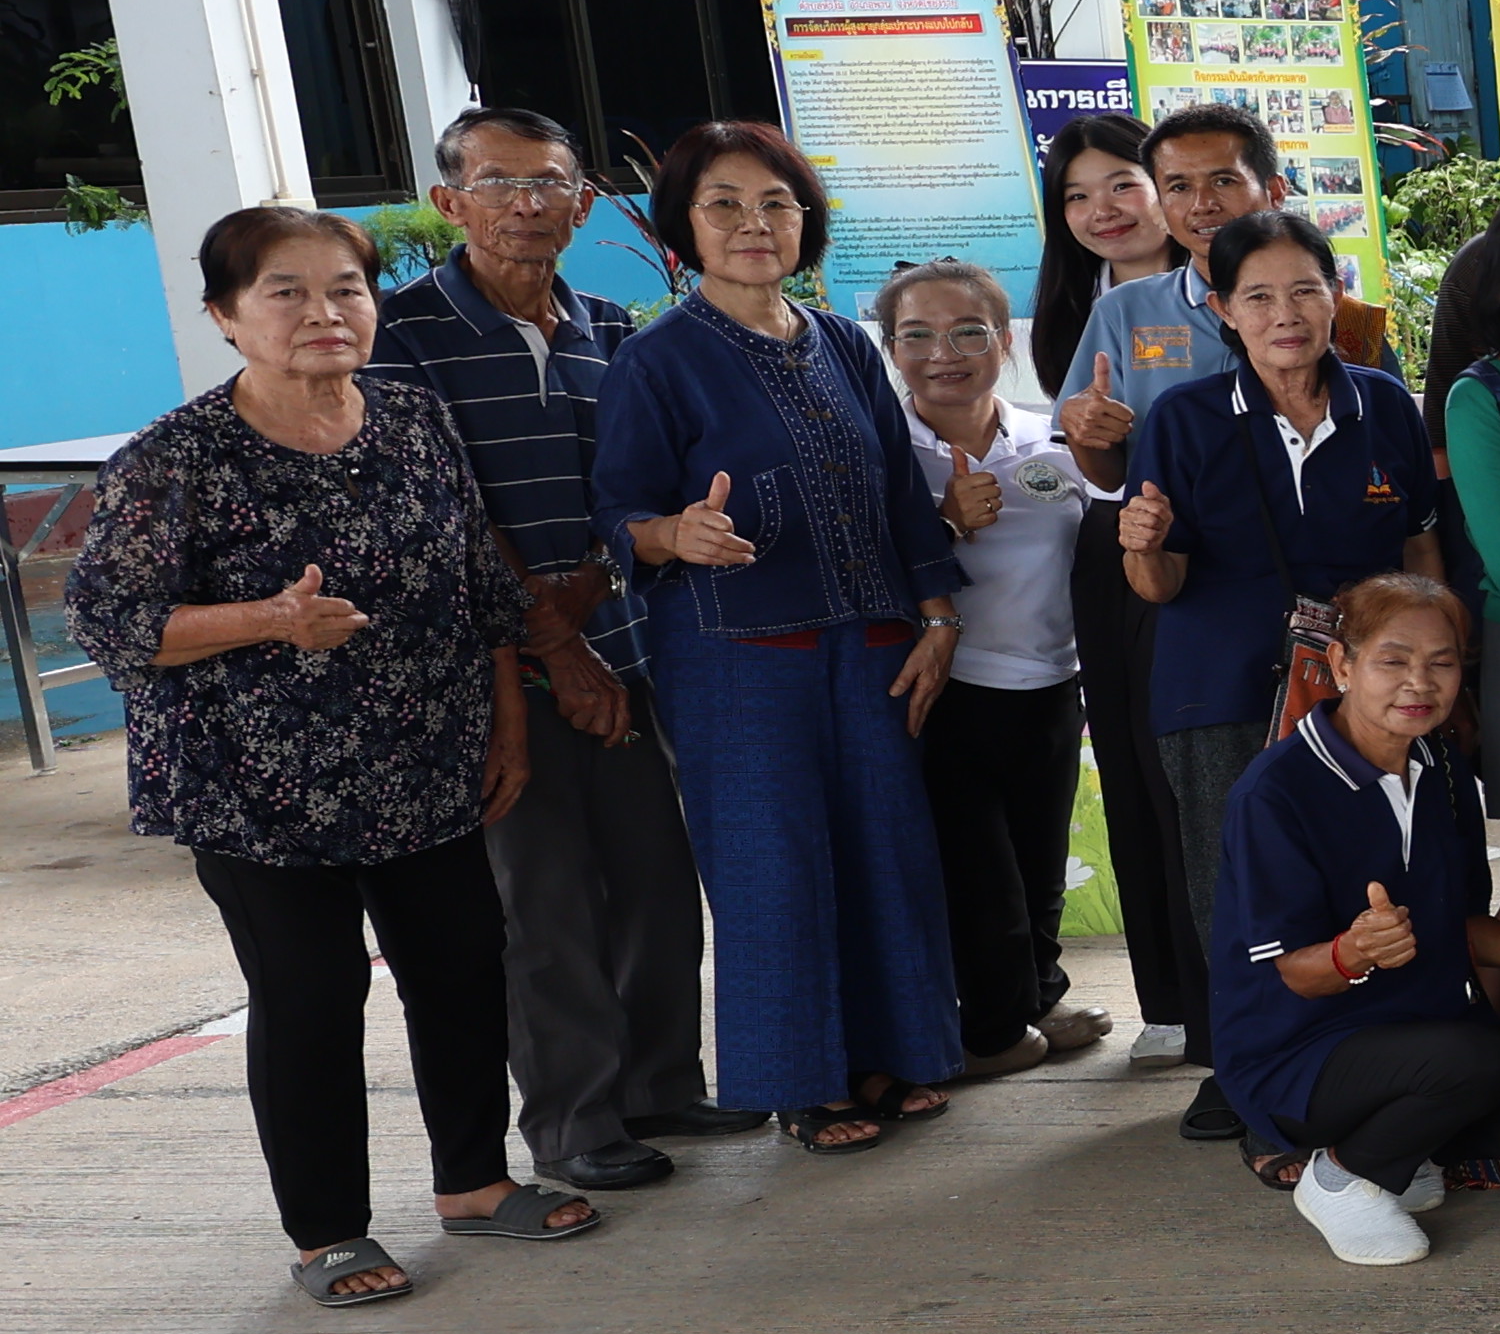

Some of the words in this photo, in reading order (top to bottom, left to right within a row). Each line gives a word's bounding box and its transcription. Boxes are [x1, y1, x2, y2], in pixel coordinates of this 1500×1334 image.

[1194, 69, 1307, 85] กิจกรรมเป็นมิตรกับความตาย
